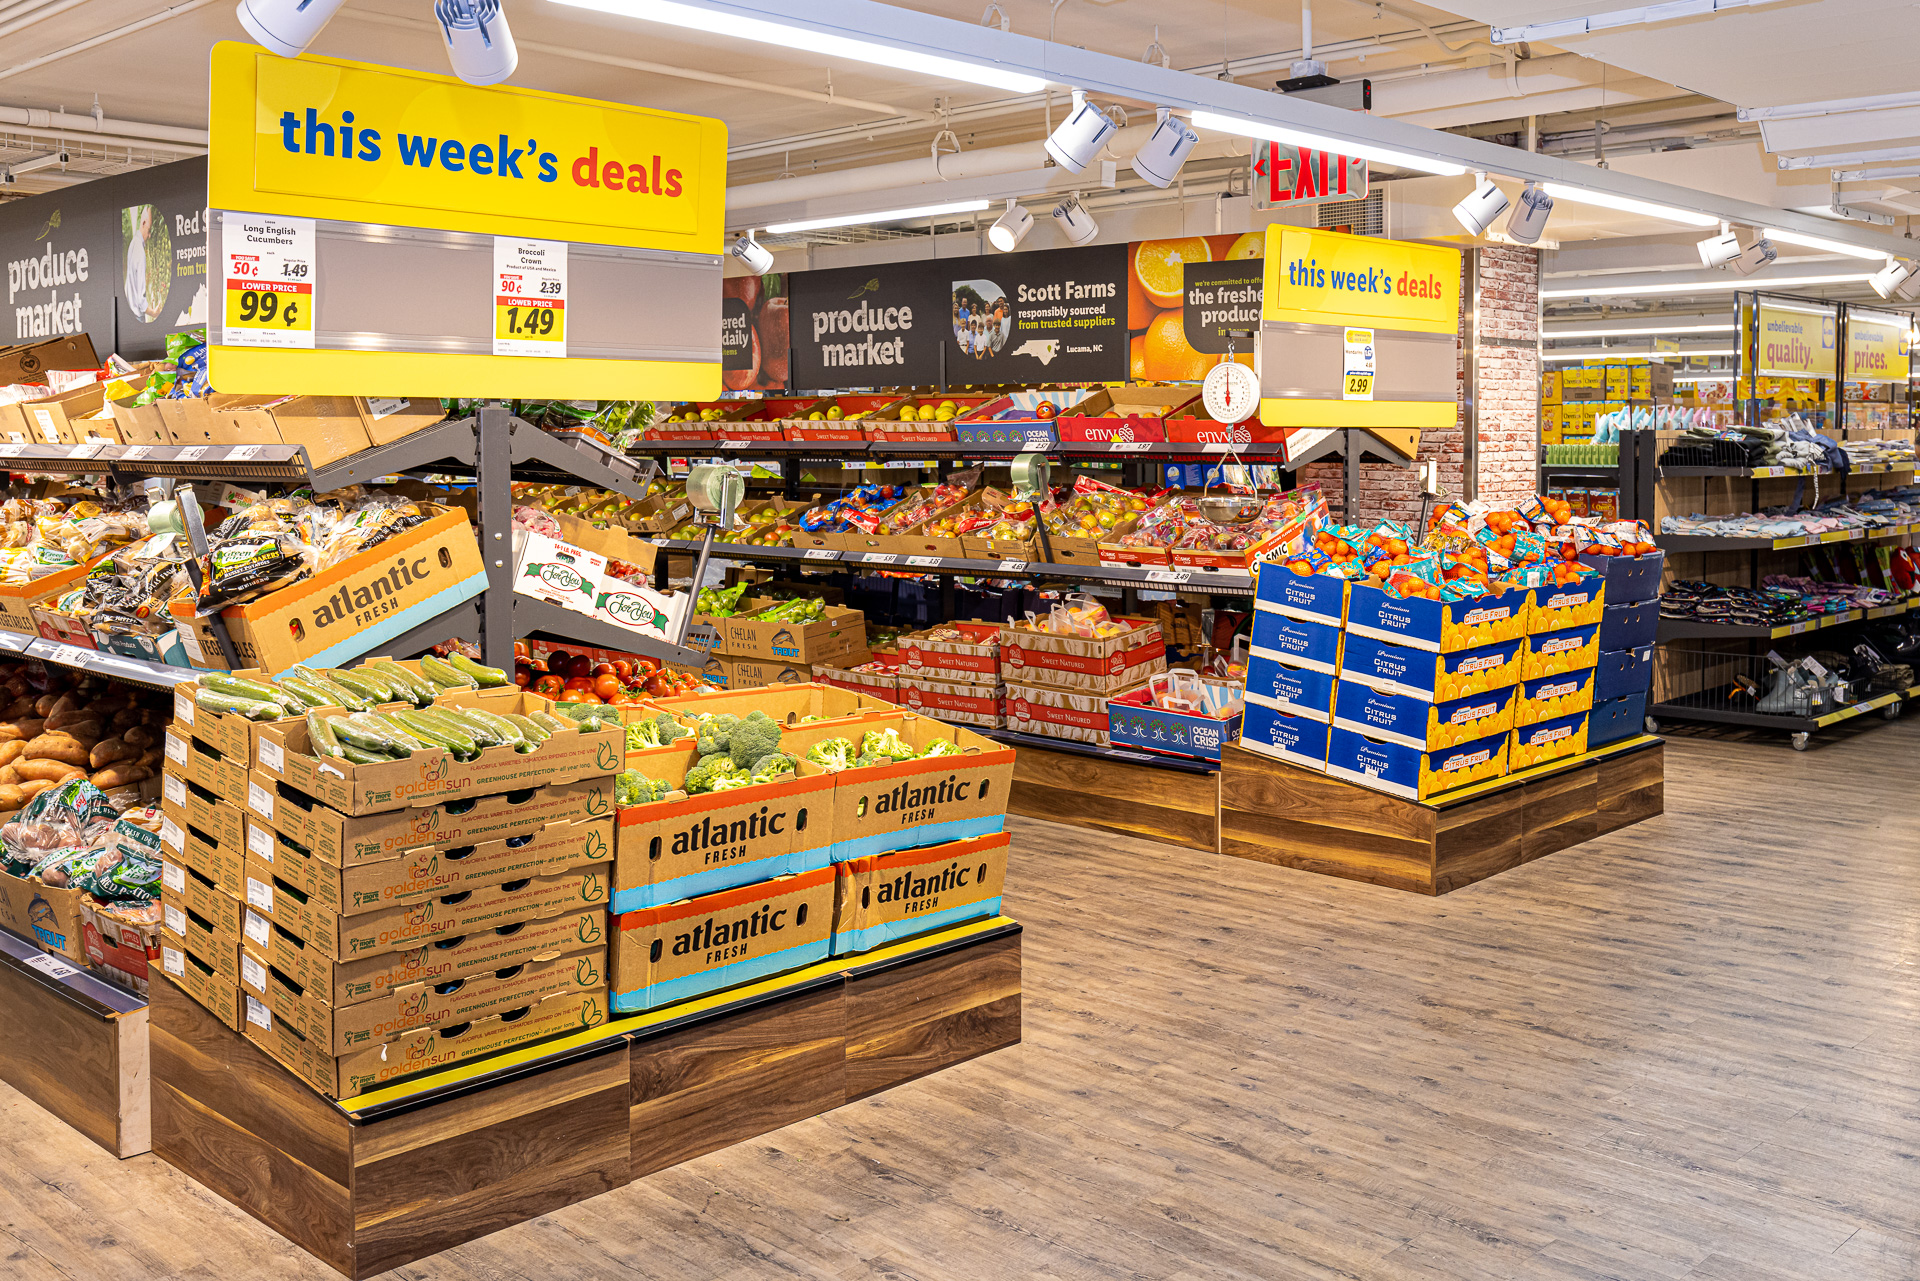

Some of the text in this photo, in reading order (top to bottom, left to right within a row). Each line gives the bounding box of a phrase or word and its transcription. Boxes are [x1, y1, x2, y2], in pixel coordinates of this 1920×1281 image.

[280, 107, 683, 197] this week's deals
[175, 210, 199, 237] Red
[244, 224, 296, 236] Long English
[247, 235, 293, 245] Cucumbers
[518, 247, 545, 256] Broccoli
[233, 262, 250, 275] 50
[520, 257, 542, 265] Crown
[8, 242, 89, 304] produce
[177, 263, 194, 277] from
[281, 263, 308, 277] 1.49
[242, 282, 297, 293] LOWER PRICE
[501, 280, 515, 292] 90
[540, 281, 562, 294] 2.39
[1195, 279, 1210, 287] we're
[1211, 278, 1243, 286] committed
[1289, 259, 1442, 300] this week's deals
[1018, 281, 1116, 303] Scott Farms
[1188, 288, 1214, 306] the
[240, 291, 298, 327] 99 ¢
[508, 298, 553, 308] LOWER PRICE
[16, 290, 82, 338] market
[1018, 304, 1106, 320] responsibly sourced
[507, 307, 554, 335] 1.49
[812, 300, 912, 342] produce
[1018, 316, 1116, 330] from trusted suppliers
[1767, 320, 1803, 335] unbelievable
[722, 329, 749, 349] daily
[1854, 331, 1884, 343] unbelievable
[822, 334, 905, 367] market
[1066, 344, 1104, 353] Lucama, NC
[1767, 337, 1814, 370] quality.
[1854, 344, 1888, 374] prices.
[1349, 378, 1368, 393] 2.99
[1027, 430, 1048, 438] OCEAN
[1253, 543, 1288, 573] CSMIC
[542, 564, 581, 587] For You
[313, 557, 430, 629] atlantic
[1285, 587, 1316, 600] CITRUS
[1288, 595, 1312, 606] FRUIT
[1548, 593, 1588, 608] CITRUS FRUIT
[355, 597, 399, 627] FRESH
[609, 594, 653, 621] For You
[1464, 607, 1510, 624] CITRUS FRUIT
[1378, 610, 1411, 624] CITRUS
[1381, 618, 1407, 629] FRUIT
[731, 626, 756, 642] CHELAN
[1278, 634, 1308, 647] CITRUS
[199, 640, 257, 660] VEGEBLES
[732, 641, 757, 650] FRESH
[771, 646, 800, 657] TROUT
[1281, 642, 1305, 652] FRUIT
[1542, 637, 1582, 654] CITRUS FRUIT
[938, 656, 979, 669] SWEET NATURED
[1041, 656, 1085, 669] SWEET NATURED
[1374, 658, 1407, 672] CITRUS
[1458, 654, 1504, 674] CITRUS FRUIT
[737, 664, 763, 679] CHELAN
[1377, 666, 1403, 677] FRUIT
[738, 678, 763, 686] FRESH
[937, 697, 977, 710] SWEET NATURED
[1046, 711, 1091, 724] SWEET NATURED
[1451, 703, 1497, 724] CITRUS FRUIT
[1193, 726, 1219, 737] OCEAN
[1269, 728, 1300, 741] CITRUS
[1193, 734, 1219, 747] CRISP
[1272, 736, 1296, 747] FRUIT
[470, 762, 497, 772] FLAVORFUL
[522, 755, 547, 763] TOMATOES
[1357, 754, 1389, 769] CITRUS
[476, 773, 518, 784] GREENHOUSE
[567, 764, 579, 772] year
[395, 777, 471, 799] goldensun
[875, 774, 971, 815] atlantic
[901, 808, 935, 824] FRESH
[671, 805, 786, 855] atlantic
[384, 828, 461, 851] goldensun
[704, 844, 747, 865] FRESH
[384, 871, 460, 899] goldensun
[877, 862, 971, 904] atlantic
[905, 897, 939, 914] FRESH
[31, 924, 67, 951] TROUT
[122, 929, 140, 945] APPLES
[379, 918, 455, 944] goldensun
[672, 904, 787, 956] atlantic
[706, 942, 748, 965] FRESH
[375, 962, 451, 989] goldensun
[373, 1007, 450, 1036] goldensun
[379, 1049, 456, 1081] goldensun
